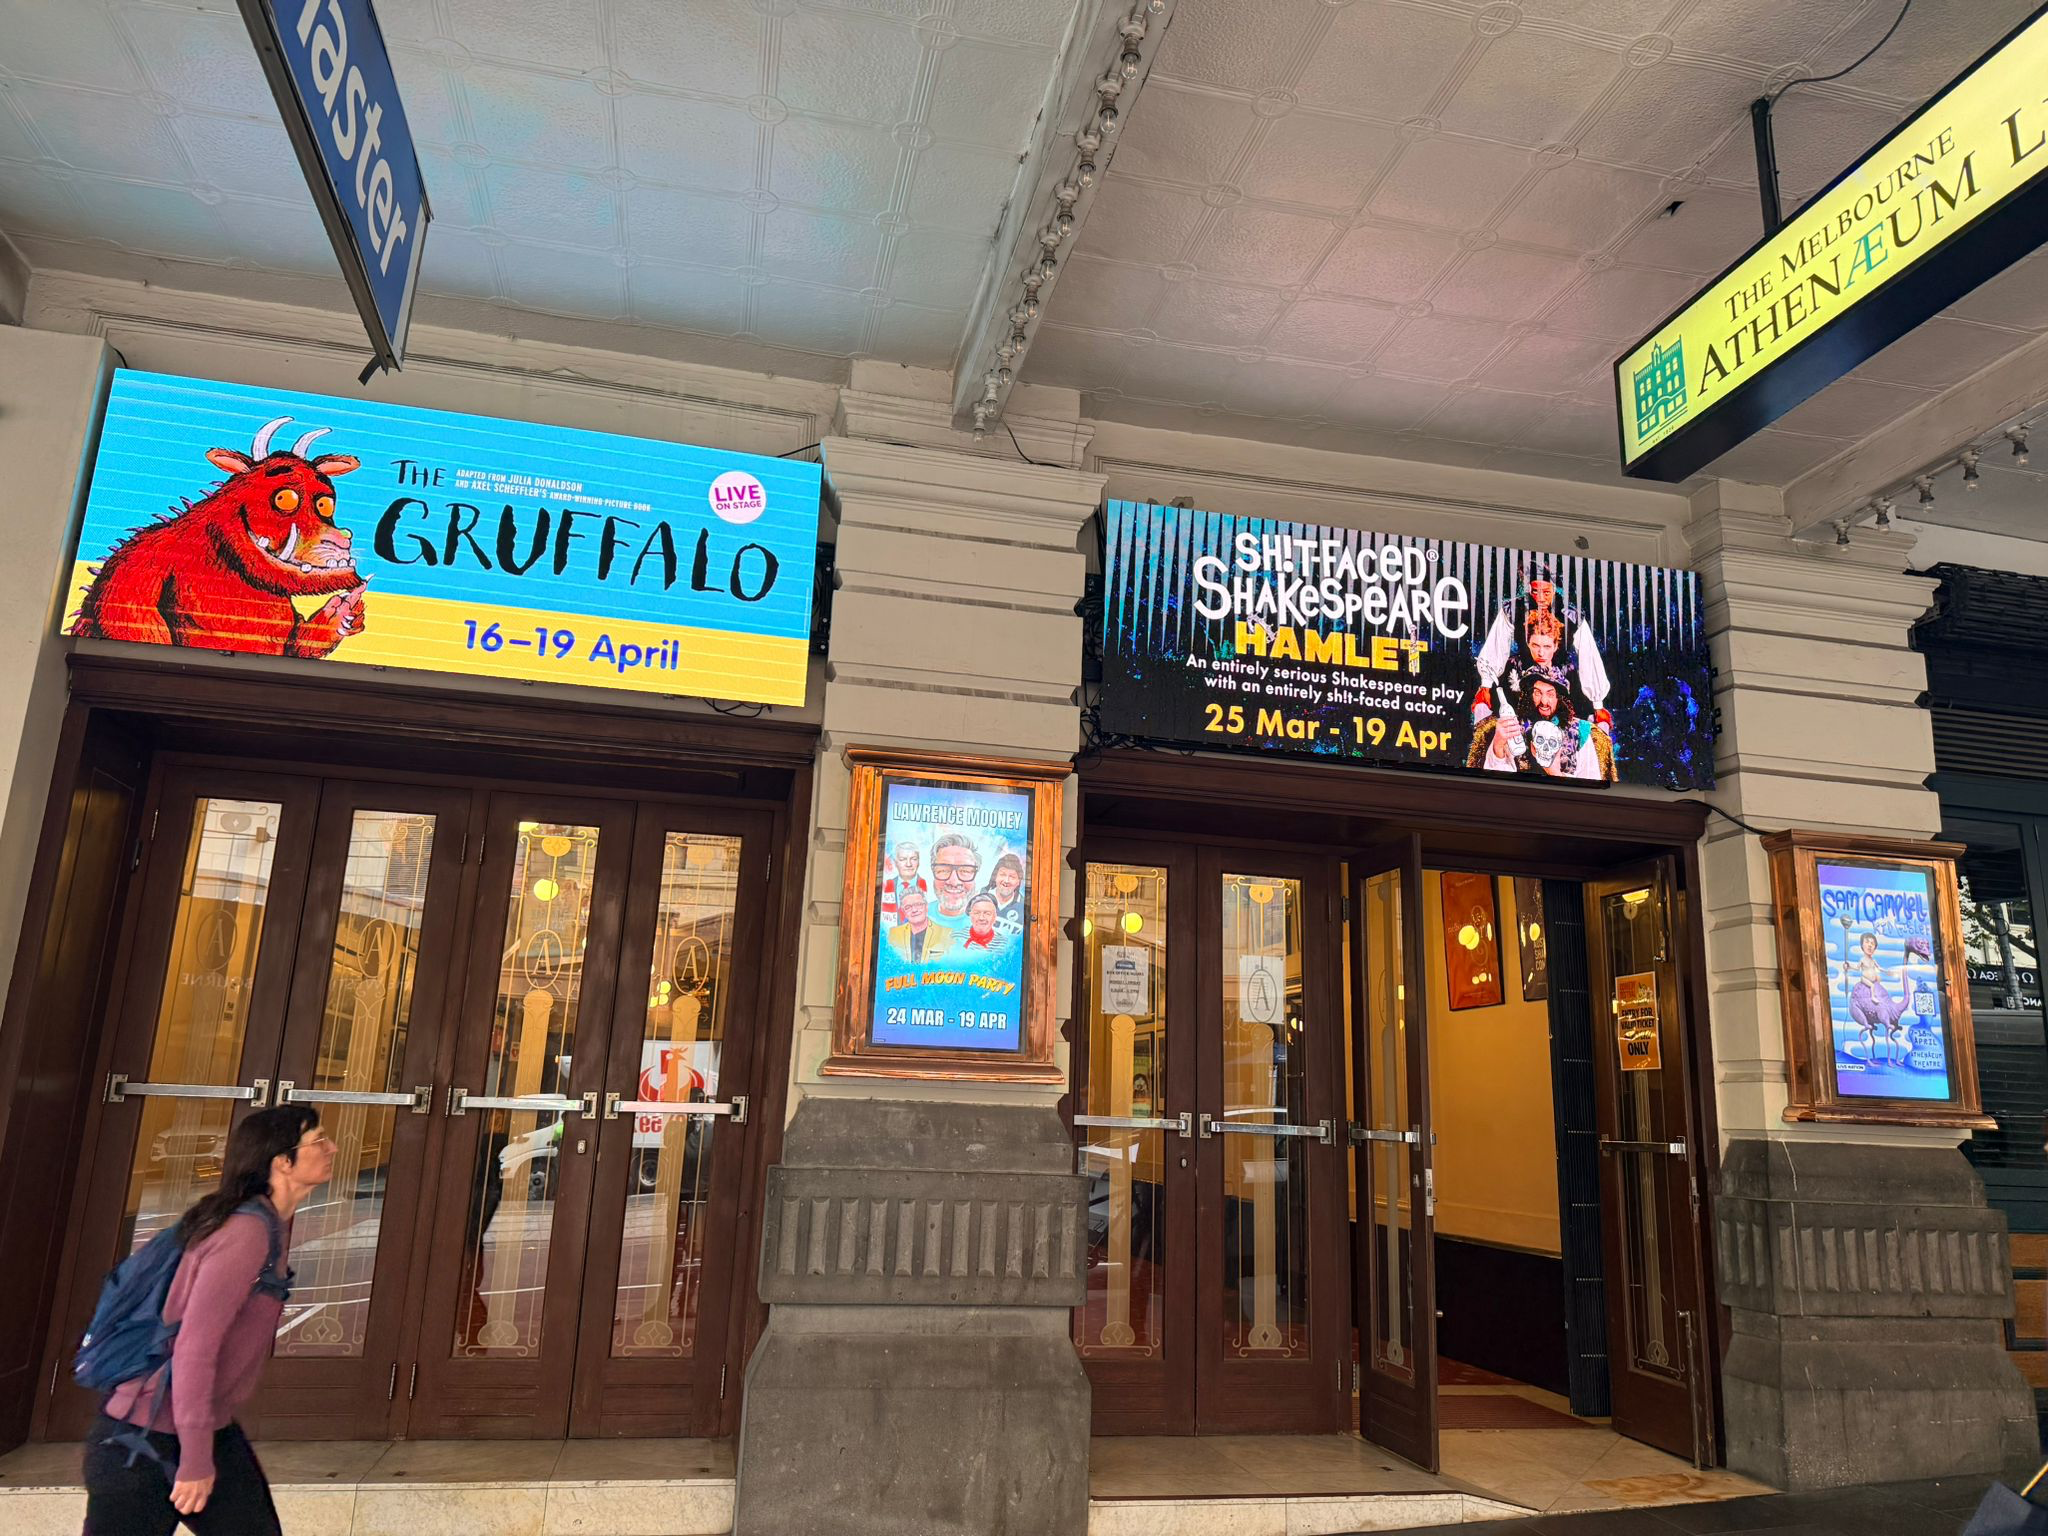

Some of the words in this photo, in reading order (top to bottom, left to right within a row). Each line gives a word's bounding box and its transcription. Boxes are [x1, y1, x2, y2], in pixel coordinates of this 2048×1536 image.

[297, 0, 407, 277] aster
[1724, 271, 1774, 323] THE
[1779, 126, 1955, 282] MELBOURNE
[390, 459, 447, 488] THE
[456, 469, 486, 480] ADAPTED
[488, 473, 507, 483] FROM
[508, 474, 532, 486] JULIA
[535, 479, 583, 493] DONALDSON
[455, 479, 469, 489] AND
[471, 482, 491, 492] AXEL
[494, 483, 548, 499] SCHEFFLER'S
[549, 491, 603, 506] AWARD-WINNING
[604, 500, 632, 510] PICTURE
[633, 502, 652, 512] BOOK
[715, 484, 761, 502] LIVE
[716, 502, 731, 510] ON
[733, 500, 762, 510] STAGE
[373, 497, 780, 602] GRUFFALO
[588, 634, 680, 674] April
[1235, 621, 1428, 675] HAMLET
[1186, 653, 1207, 669] An
[1212, 659, 1269, 680] entirely
[1274, 666, 1327, 684] serious
[1332, 671, 1427, 696] Shakespeare
[1431, 683, 1464, 703] play
[1204, 675, 1238, 691] with
[1241, 681, 1260, 693] an
[1265, 682, 1322, 703] entirely
[1405, 701, 1446, 716] actor.
[1204, 703, 1245, 734] 25
[1255, 708, 1320, 740] Mar
[1353, 716, 1386, 746] 19
[1395, 720, 1452, 758] Apr
[893, 802, 964, 826] LAWRENCE
[967, 808, 1023, 830] MOONEY
[885, 973, 917, 992] FULL
[921, 971, 966, 985] MOON
[968, 974, 1016, 996] PARTY
[887, 1007, 906, 1025] 24
[910, 1008, 944, 1026] MAR
[958, 1010, 976, 1028] 19
[978, 1011, 1007, 1030] APR
[1637, 1019, 1654, 1029] TICKET
[1628, 1041, 1649, 1056] ONLY
